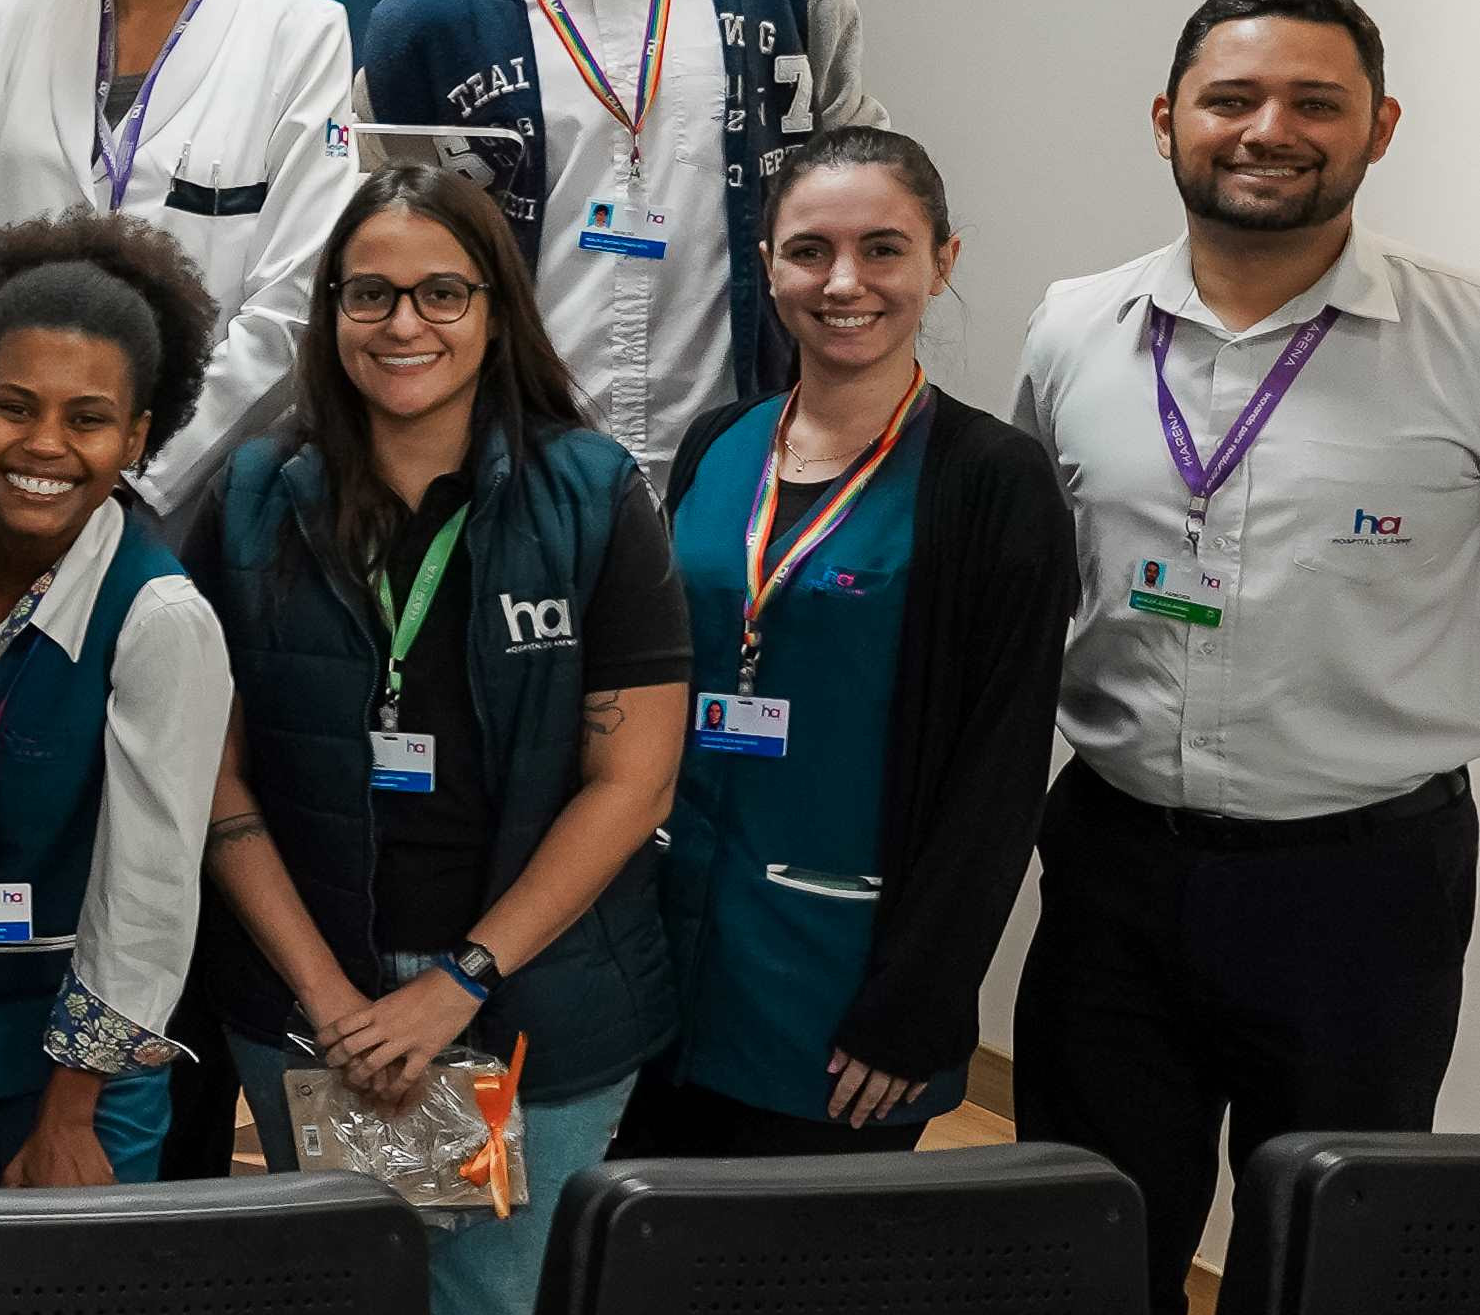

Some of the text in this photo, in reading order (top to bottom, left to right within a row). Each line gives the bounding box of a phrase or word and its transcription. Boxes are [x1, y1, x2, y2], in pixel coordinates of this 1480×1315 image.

[774, 54, 814, 133] 7
[646, 210, 665, 226] ha
[1284, 323, 1320, 367] ARENA
[1166, 410, 1193, 468] HARENA
[1353, 508, 1402, 535] ha
[1201, 572, 1221, 589] ha
[498, 593, 573, 643] ha
[761, 703, 781, 719] ha
[406, 739, 425, 755] ha
[2, 889, 24, 903] ha
